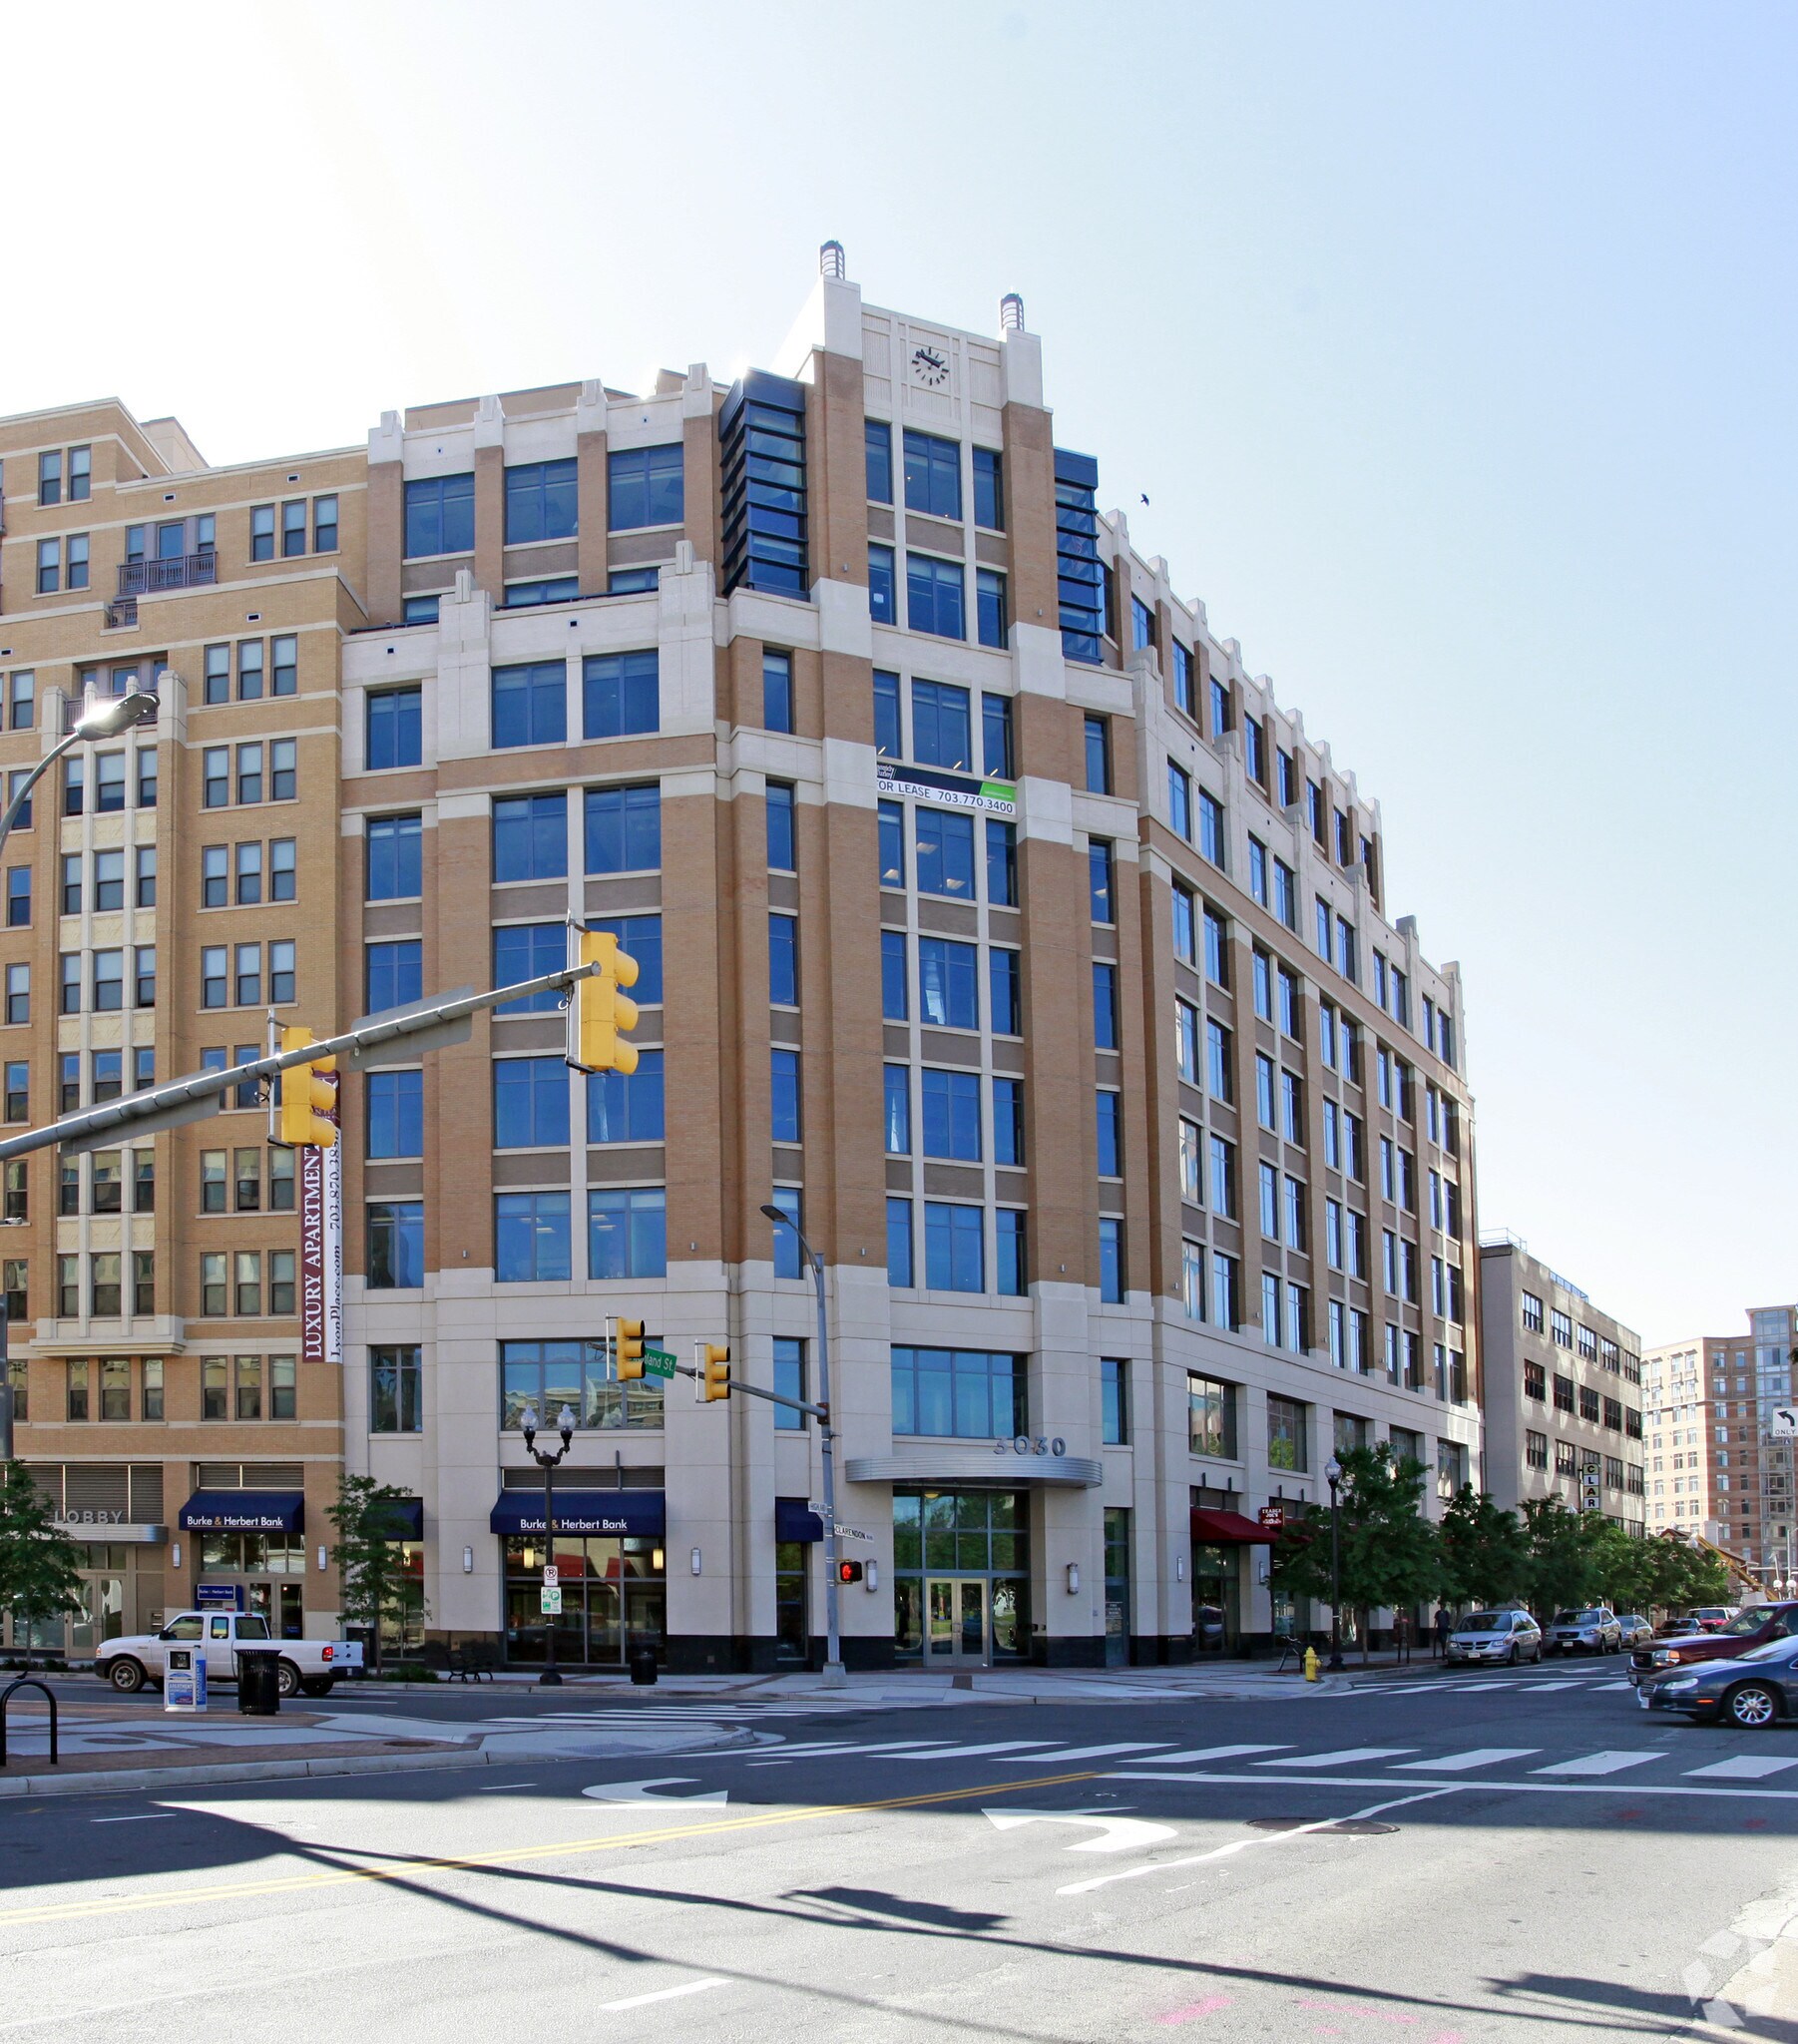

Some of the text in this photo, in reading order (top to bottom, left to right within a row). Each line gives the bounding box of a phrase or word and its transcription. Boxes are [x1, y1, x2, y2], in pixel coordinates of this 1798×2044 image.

[877, 779, 894, 792] OR
[898, 783, 931, 798] LEASE
[938, 790, 1013, 813] 703.770.3400
[329, 1245, 340, 1357] LyonPlace.com
[304, 1274, 322, 1357] LUXURY
[663, 1357, 674, 1372] St.
[993, 1435, 1066, 1457] 3030
[54, 1510, 124, 1525] LOBBY
[187, 1516, 283, 1528] Burke & Herbert Bank
[520, 1518, 628, 1529] Burke & Herbert Bank
[835, 1526, 866, 1540] CLARENDON
